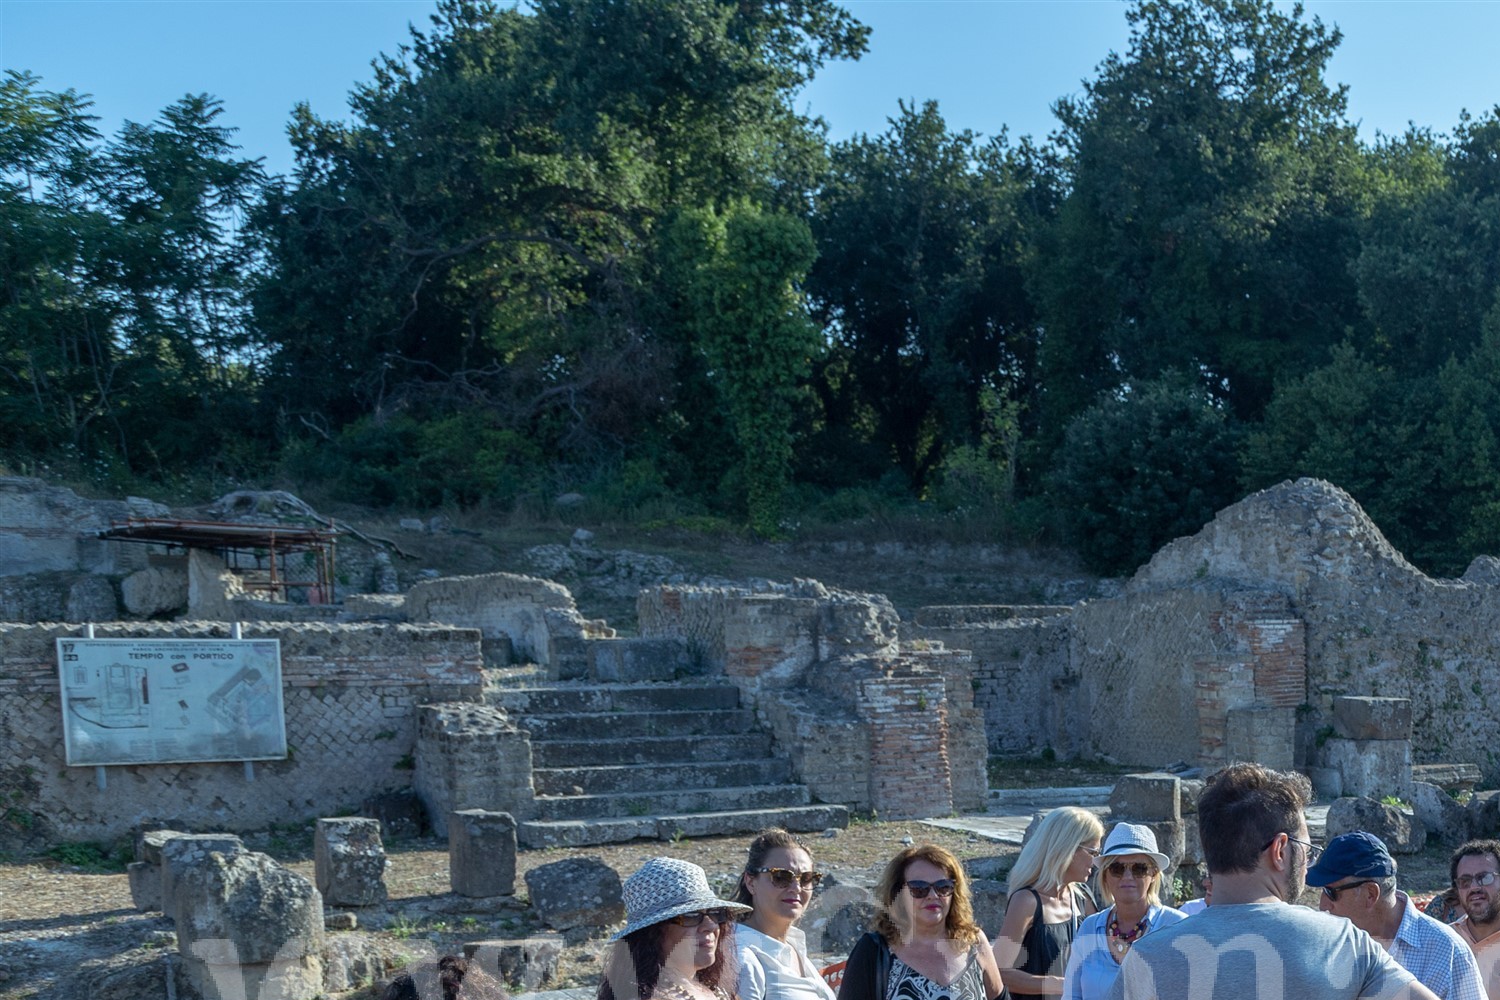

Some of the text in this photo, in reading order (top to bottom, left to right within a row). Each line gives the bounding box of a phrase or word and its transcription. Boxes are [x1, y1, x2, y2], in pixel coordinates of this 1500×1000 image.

[62, 643, 75, 653] 17
[128, 652, 164, 660] TEMPIO
[193, 652, 234, 660] PORTICO
